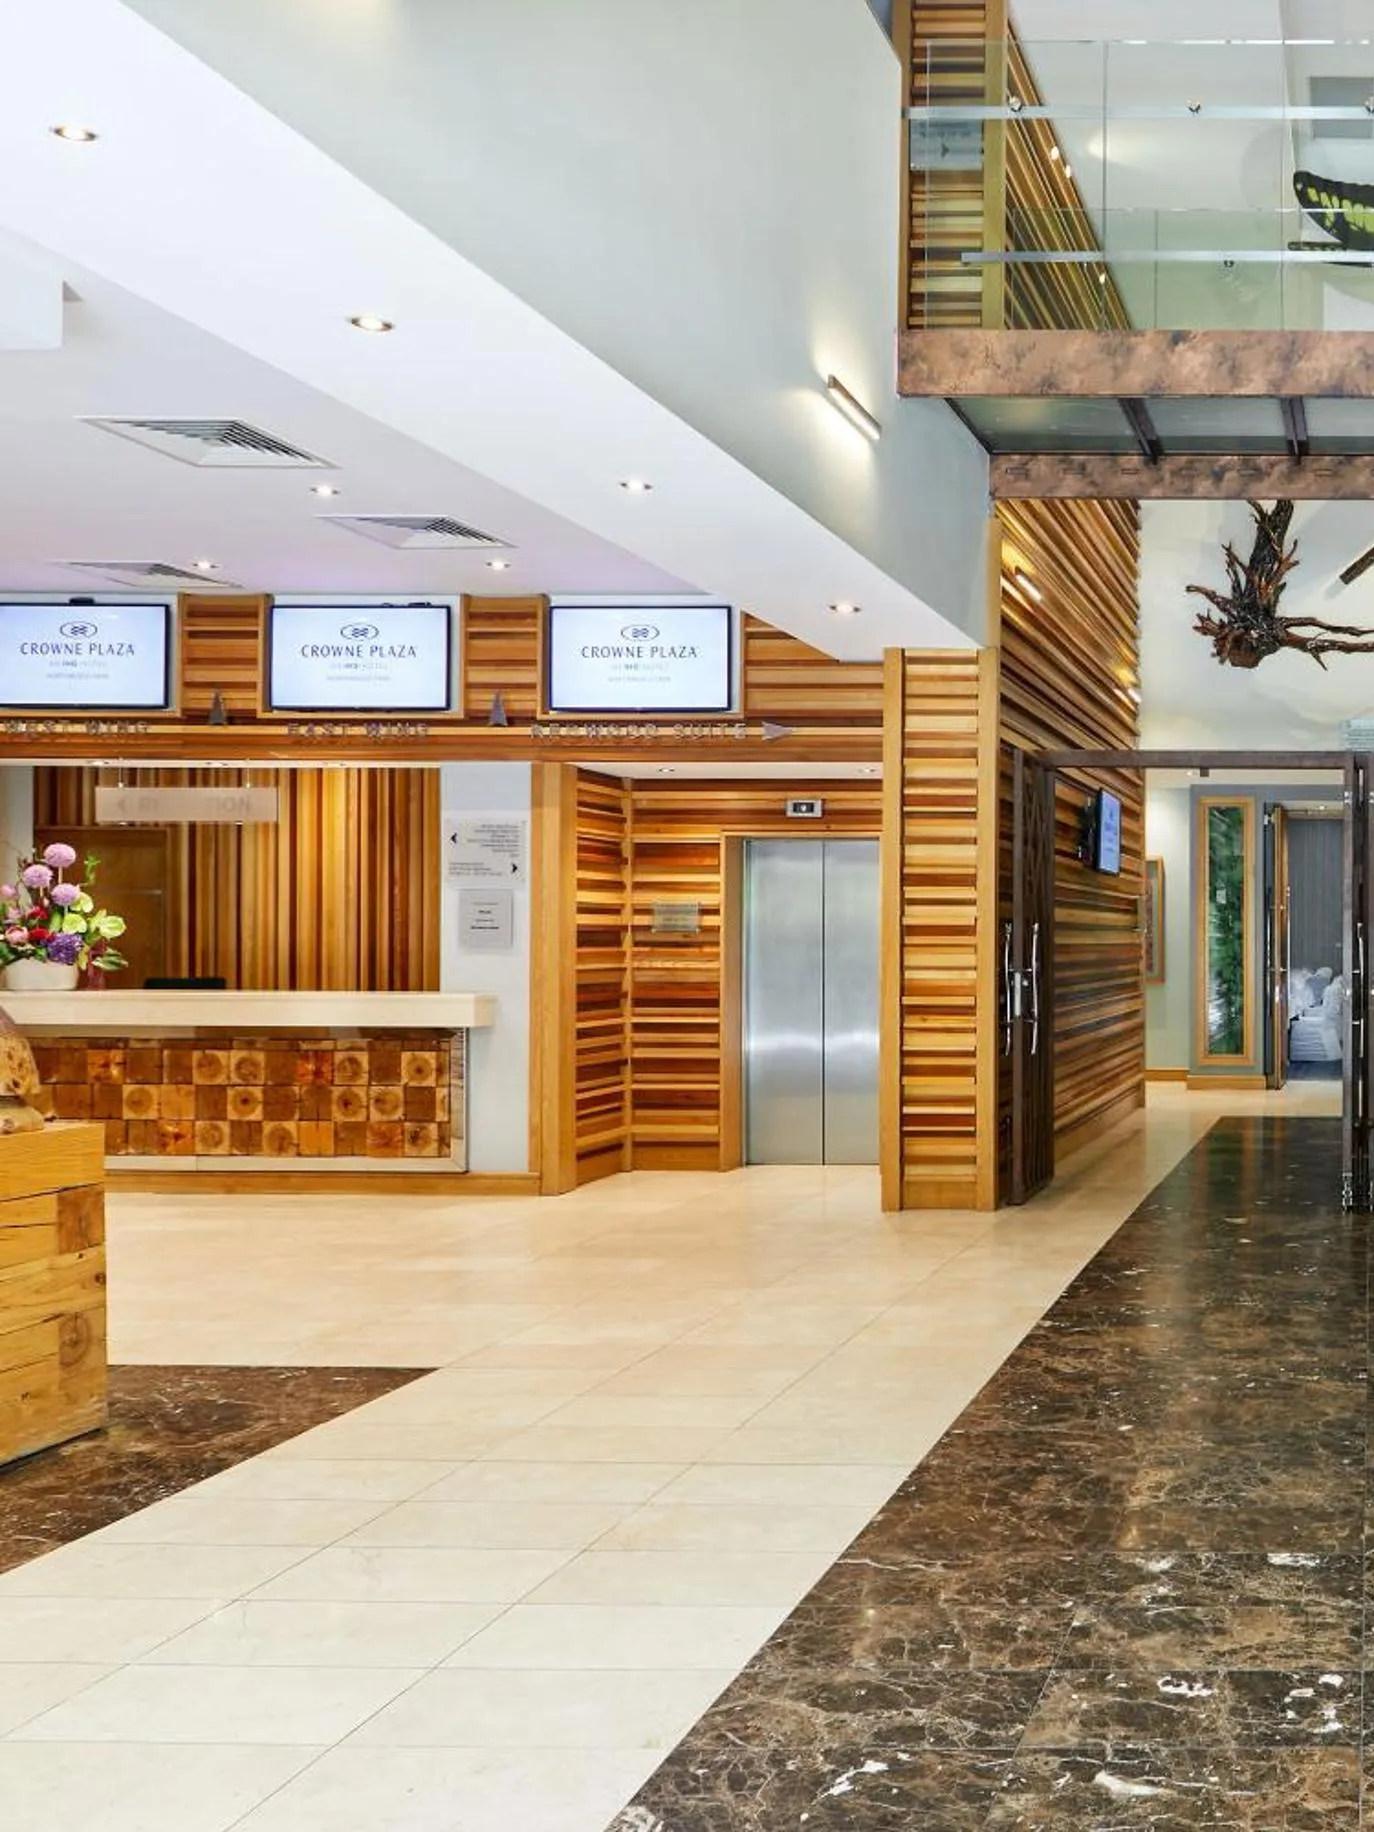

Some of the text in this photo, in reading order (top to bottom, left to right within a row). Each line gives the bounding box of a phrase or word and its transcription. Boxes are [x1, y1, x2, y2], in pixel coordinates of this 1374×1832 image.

[20, 642, 135, 656] CROWNE PLAZA
[301, 644, 417, 658] CROWNE PLAZA
[581, 645, 698, 658] CROWNE PLAZA
[86, 720, 149, 735] WING
[287, 722, 428, 737] EAST WING
[531, 724, 746, 740] REDWOOD SUITE
